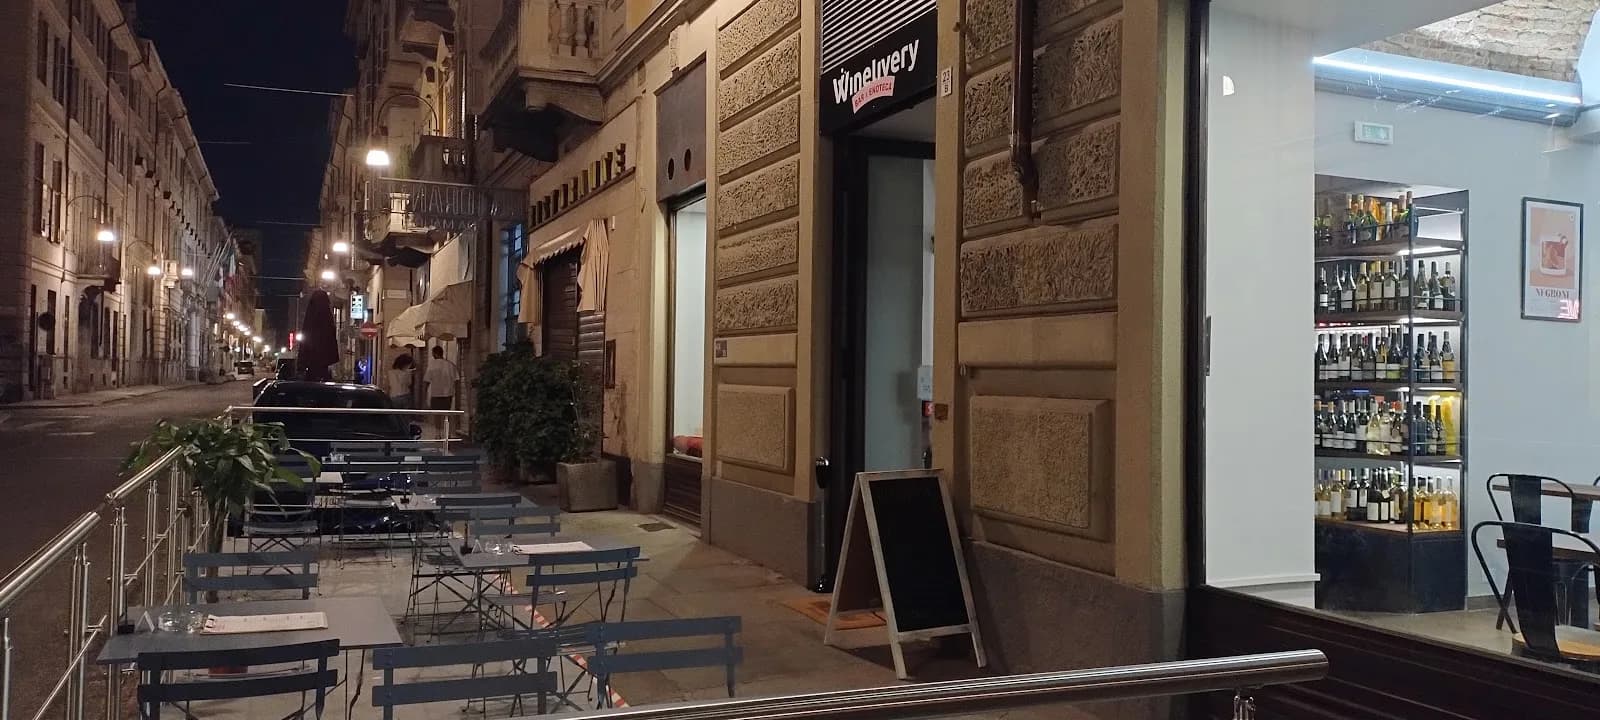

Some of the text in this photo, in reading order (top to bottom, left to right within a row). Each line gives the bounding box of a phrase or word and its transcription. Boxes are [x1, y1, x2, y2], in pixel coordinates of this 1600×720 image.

[832, 40, 920, 104] Winelivery
[854, 93, 865, 107] BAR
[868, 80, 892, 96] ENOTECA
